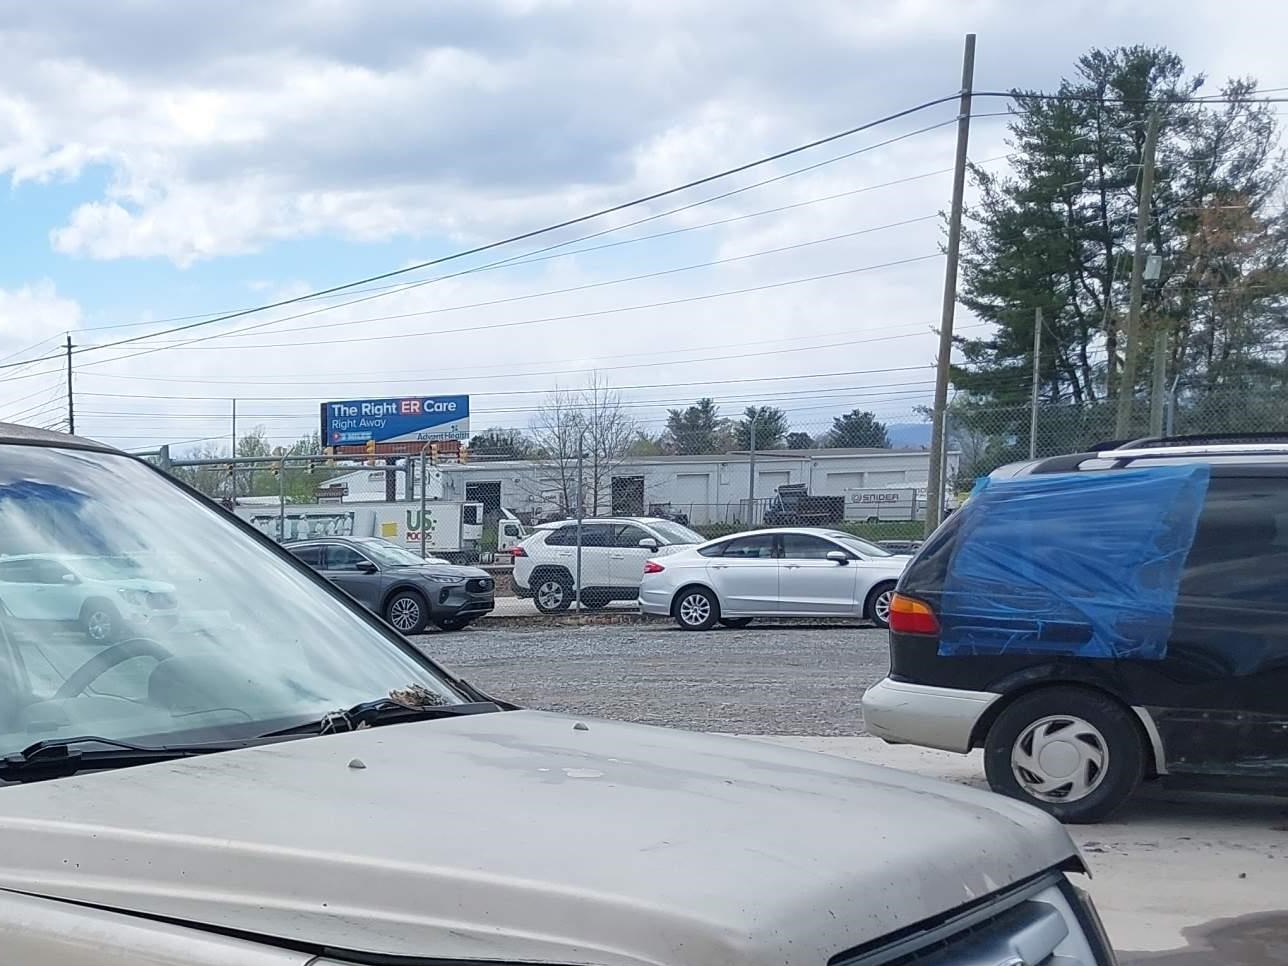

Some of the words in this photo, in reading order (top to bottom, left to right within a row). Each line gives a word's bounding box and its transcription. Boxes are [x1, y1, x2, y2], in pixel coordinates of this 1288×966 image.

[332, 404, 358, 417] The
[361, 402, 397, 418] Right
[401, 400, 421, 413] ER
[423, 399, 457, 412] Care
[331, 419, 357, 431] Right
[359, 417, 387, 429] Away
